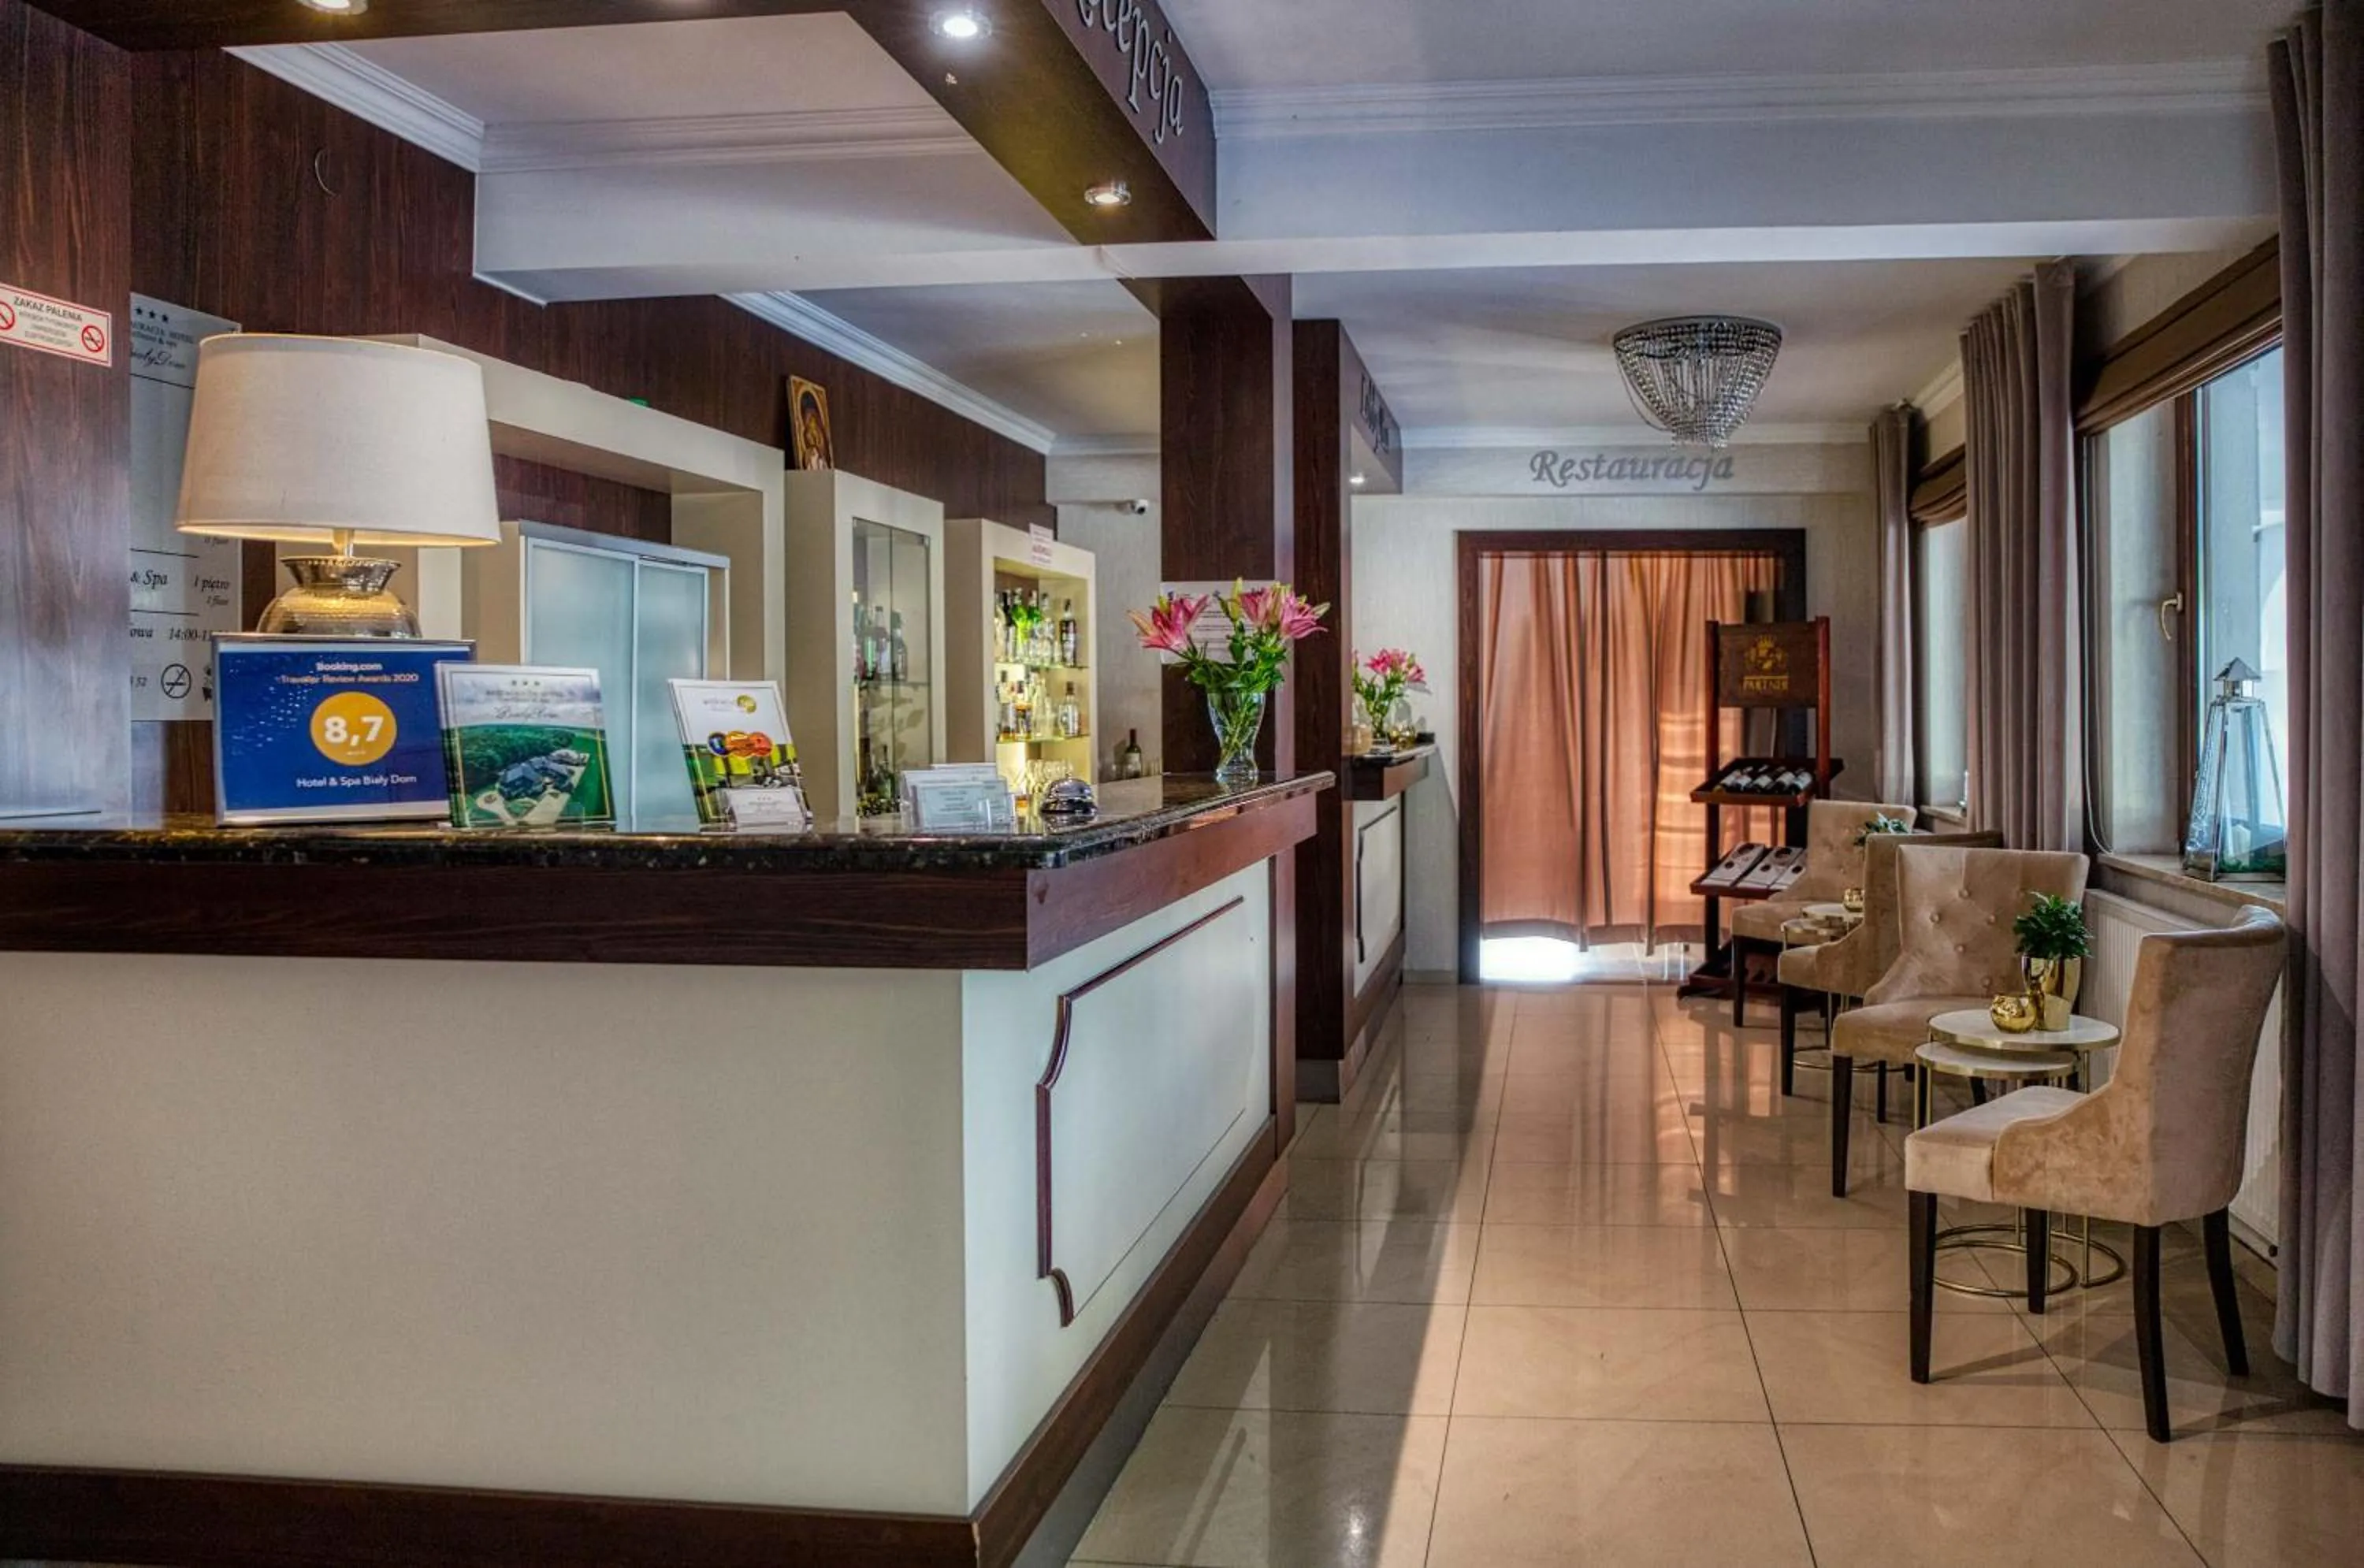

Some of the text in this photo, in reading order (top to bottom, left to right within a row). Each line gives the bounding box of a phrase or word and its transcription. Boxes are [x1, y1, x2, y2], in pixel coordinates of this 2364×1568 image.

[14, 296, 44, 311] ZAKAZ
[46, 305, 83, 321] PALENIA
[1530, 449, 1734, 491] Restauracja
[143, 570, 168, 589] Spa
[316, 661, 382, 672] Booking.com
[393, 673, 419, 682] 2020
[324, 715, 384, 747] 8,7
[296, 777, 326, 788] Hotel
[329, 777, 338, 787] &
[340, 776, 362, 787] Spa
[391, 775, 417, 784] Dom
